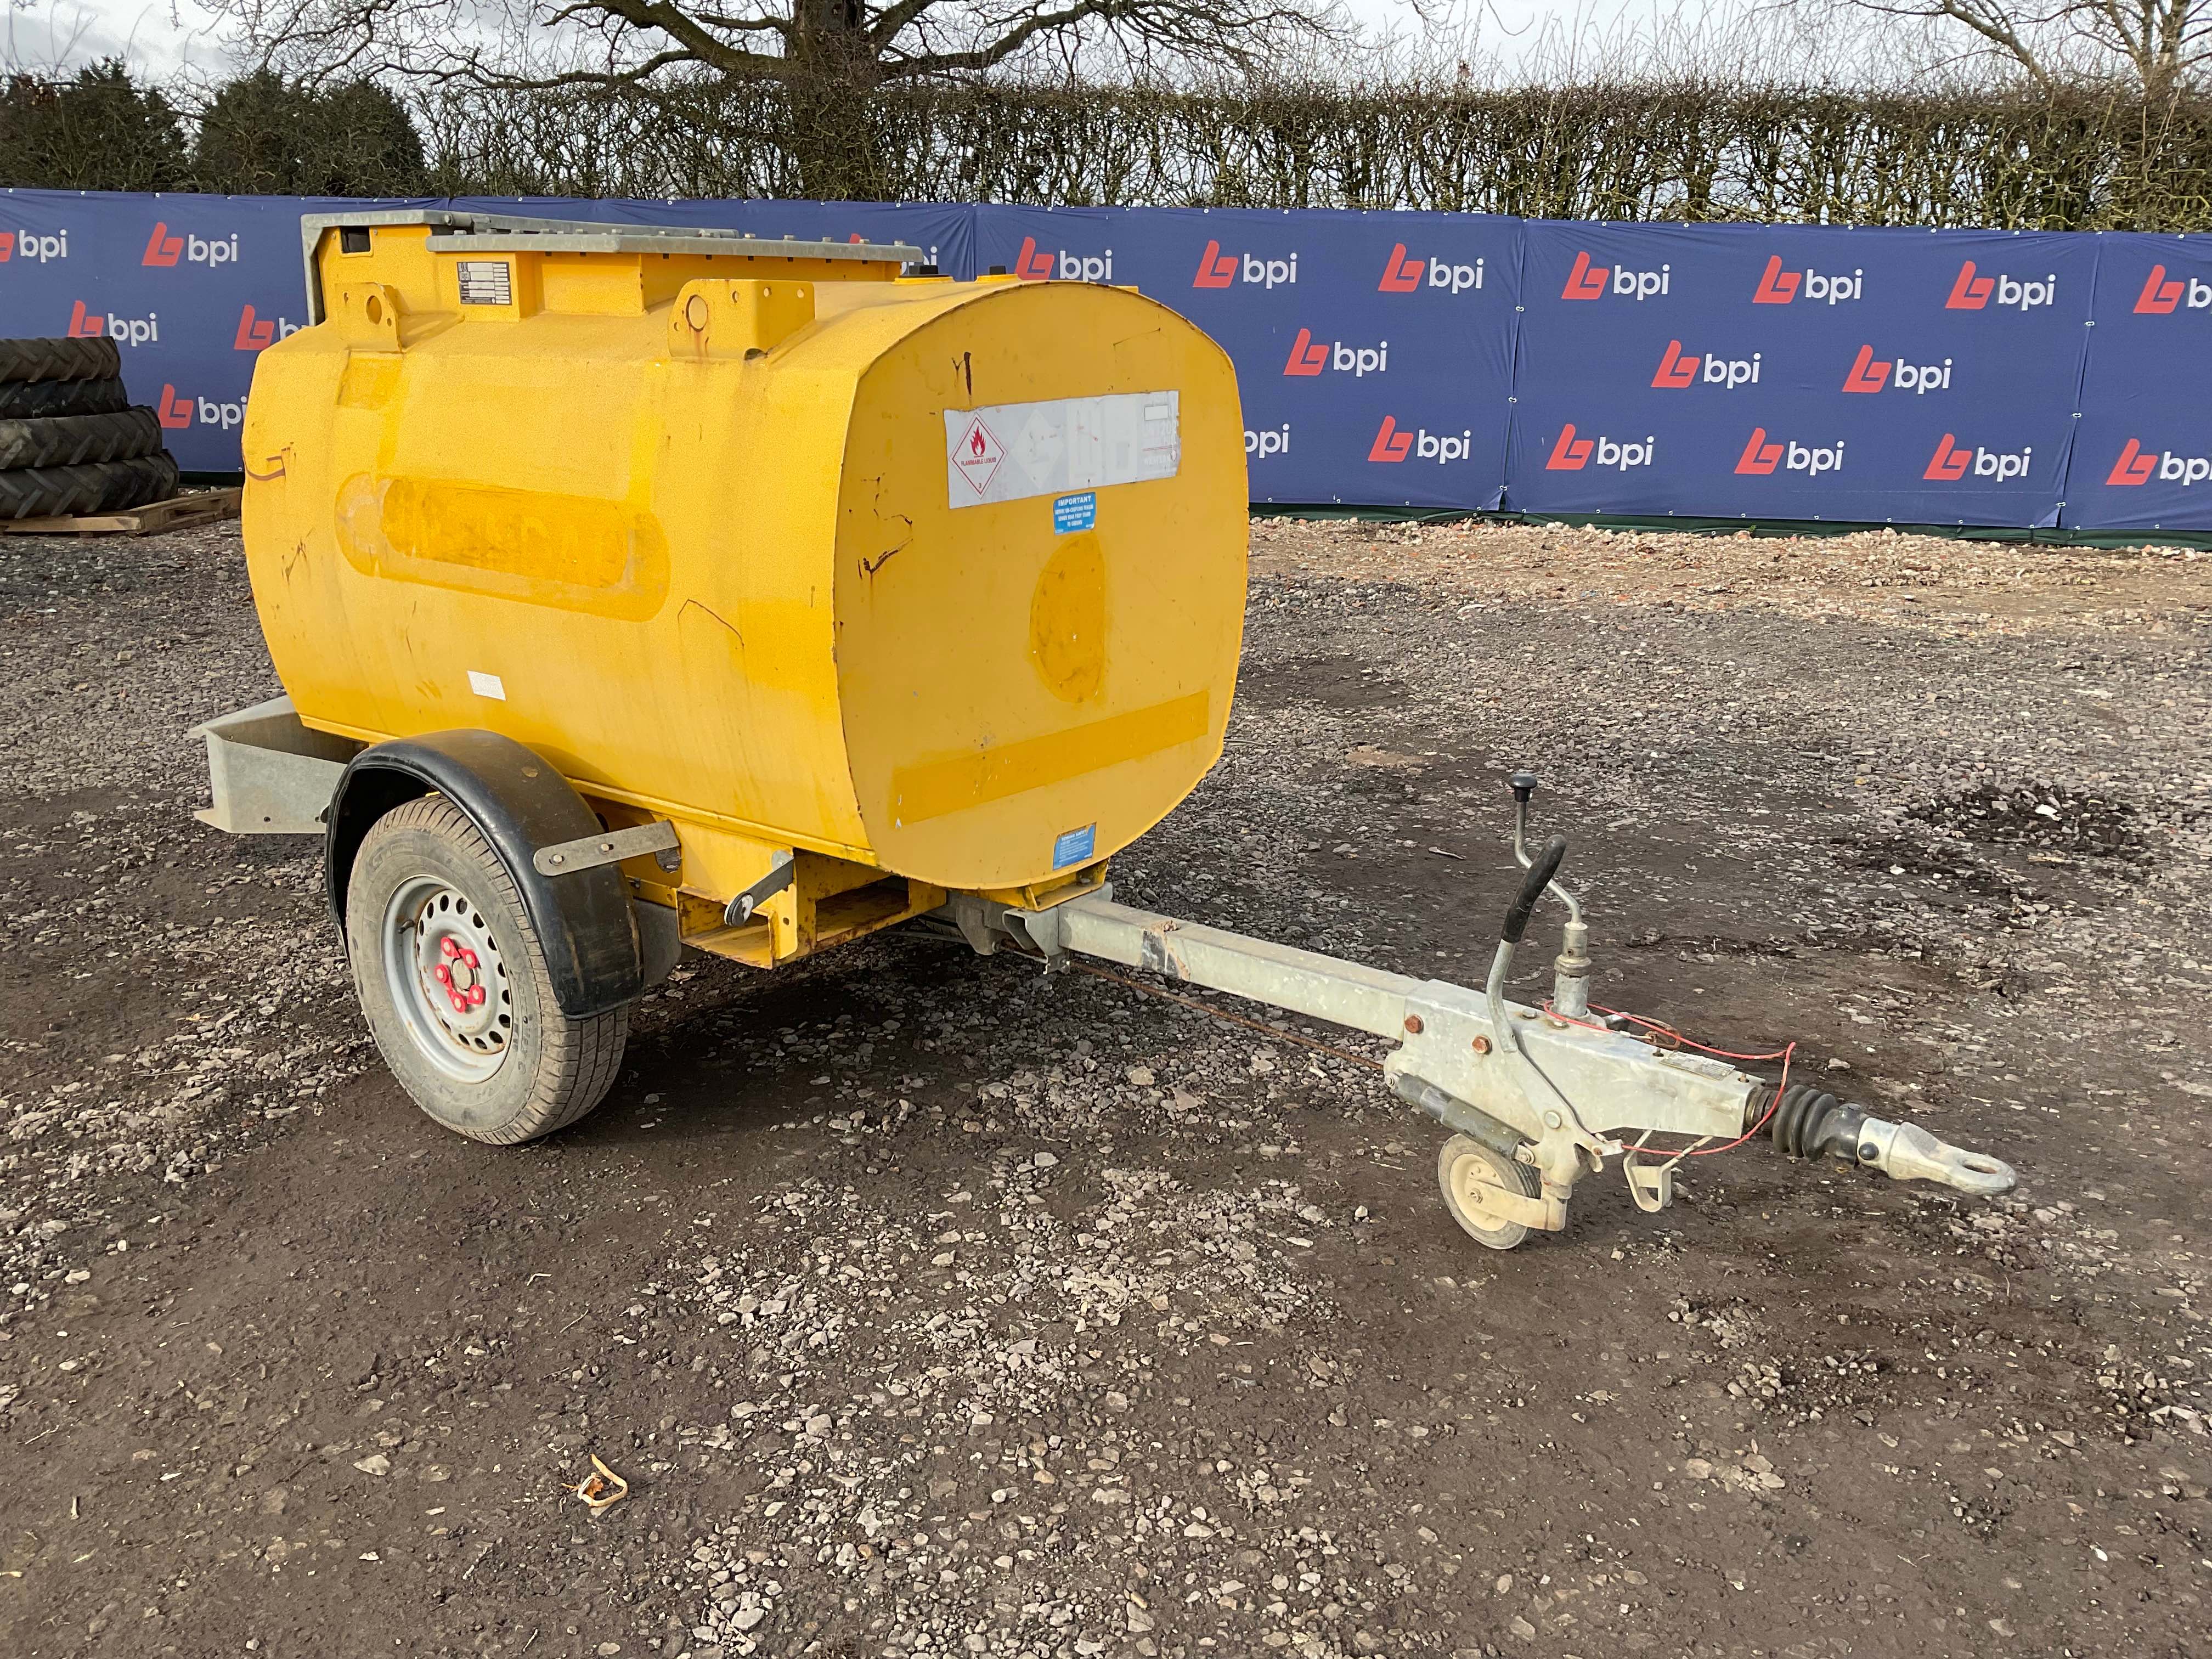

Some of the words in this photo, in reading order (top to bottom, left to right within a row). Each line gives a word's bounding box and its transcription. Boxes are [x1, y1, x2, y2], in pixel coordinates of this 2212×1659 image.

[19, 229, 67, 263] bpi
[188, 233, 238, 268] bpi
[1059, 249, 1113, 283] bpi
[1243, 252, 1297, 290] bpi
[1428, 257, 1484, 294] bpi
[1613, 264, 1670, 301] bpi
[1805, 268, 1863, 305] bpi
[1996, 274, 2056, 311] bpi
[108, 312, 157, 347] bpi
[1333, 341, 1387, 377] bpi
[1703, 352, 1761, 390] bpi
[1894, 358, 1953, 395] bpi
[1417, 429, 1471, 465] bpi
[1596, 436, 1655, 471] bpi
[1786, 441, 1845, 476] bpi
[1974, 447, 2032, 482] bpi
[1058, 495, 1092, 506] IMPORTANT
